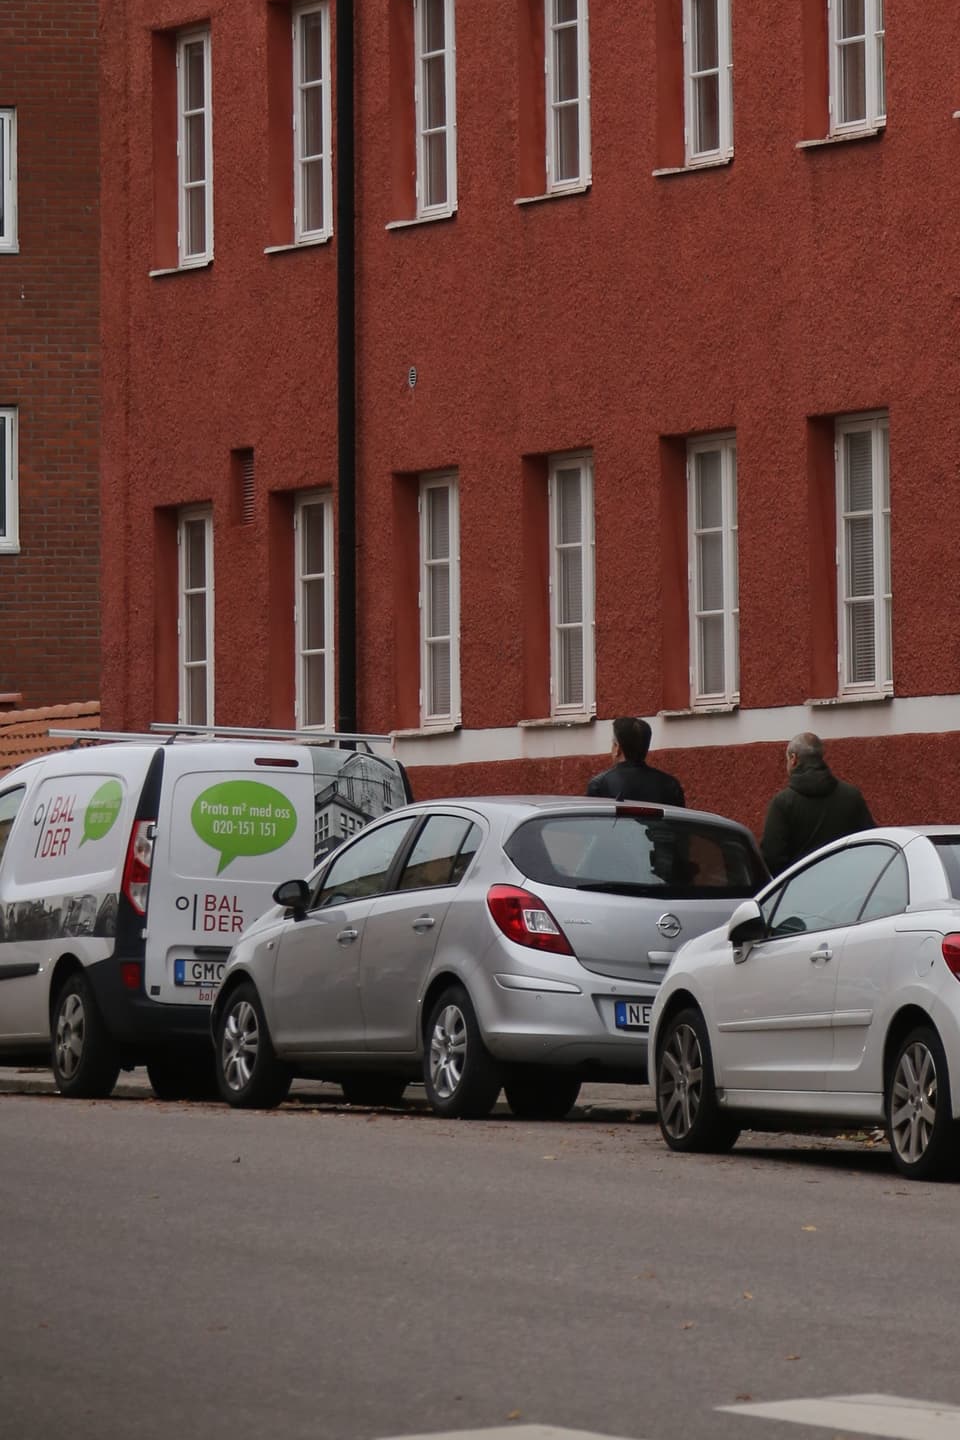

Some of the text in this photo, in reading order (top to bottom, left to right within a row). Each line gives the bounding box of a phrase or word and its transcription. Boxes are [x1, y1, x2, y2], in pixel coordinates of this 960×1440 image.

[50, 794, 75, 824] BAL
[201, 801, 228, 815] Prata
[250, 804, 271, 817] med
[275, 809, 290, 818] oss
[260, 822, 276, 837] 151
[41, 828, 70, 857] DER
[204, 894, 243, 913] BAL
[203, 915, 244, 932] DER
[198, 988, 217, 1000] bal
